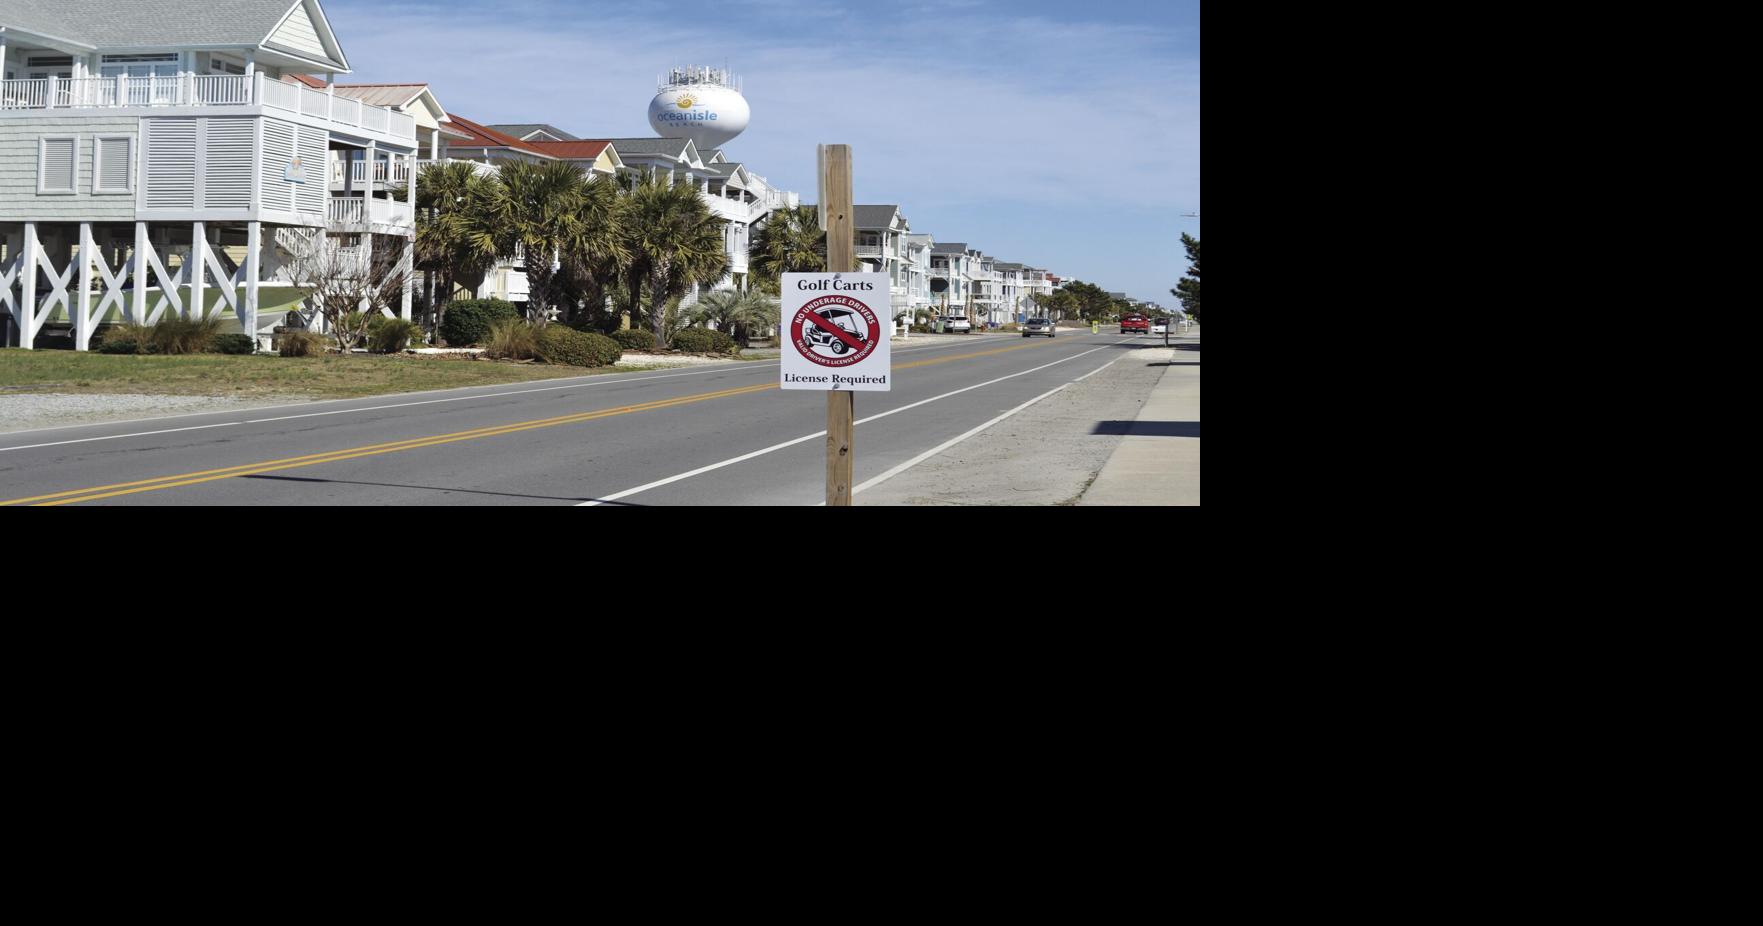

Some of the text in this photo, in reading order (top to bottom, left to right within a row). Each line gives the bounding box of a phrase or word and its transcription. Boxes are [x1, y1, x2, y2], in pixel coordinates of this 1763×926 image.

[797, 279, 873, 291] Golf Carts
[794, 297, 876, 325] NO UNDERAGE DRIVERS
[796, 339, 807, 353] VALID
[806, 351, 831, 364] DRIVER'S
[853, 339, 874, 360] REQUIRED
[784, 373, 886, 386] License Required
